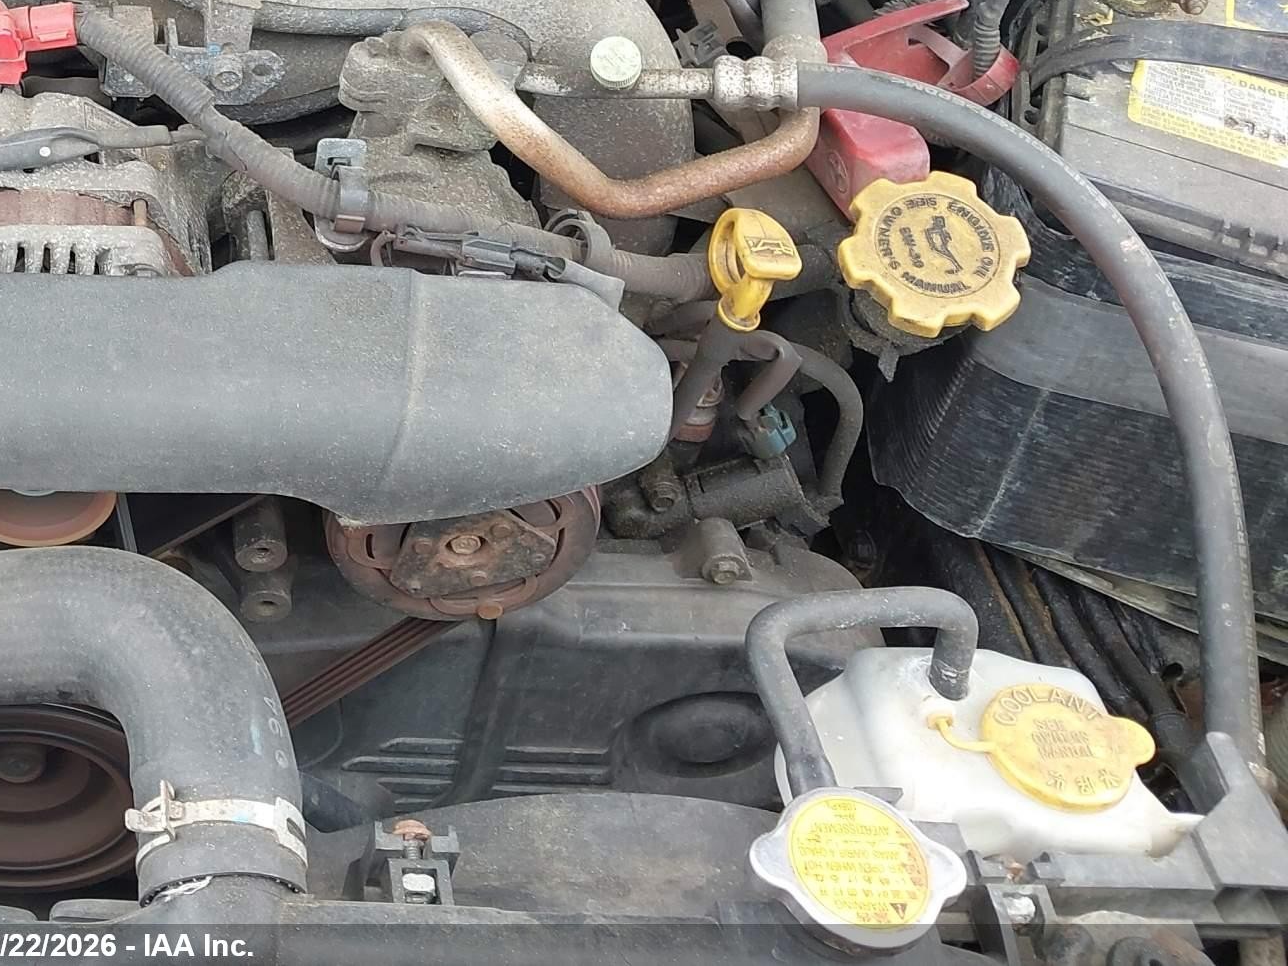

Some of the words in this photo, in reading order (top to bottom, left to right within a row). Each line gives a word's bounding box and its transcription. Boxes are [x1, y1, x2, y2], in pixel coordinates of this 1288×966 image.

[1239, 80, 1288, 100] DANGE
[905, 197, 938, 210] SEE
[876, 205, 904, 271] OWNER'S
[972, 256, 995, 280] OIL
[994, 686, 1104, 726] COOLANT
[1033, 718, 1066, 732] SEE
[810, 822, 890, 836] AVERTISSEMENT
[834, 898, 890, 912] WARNING
